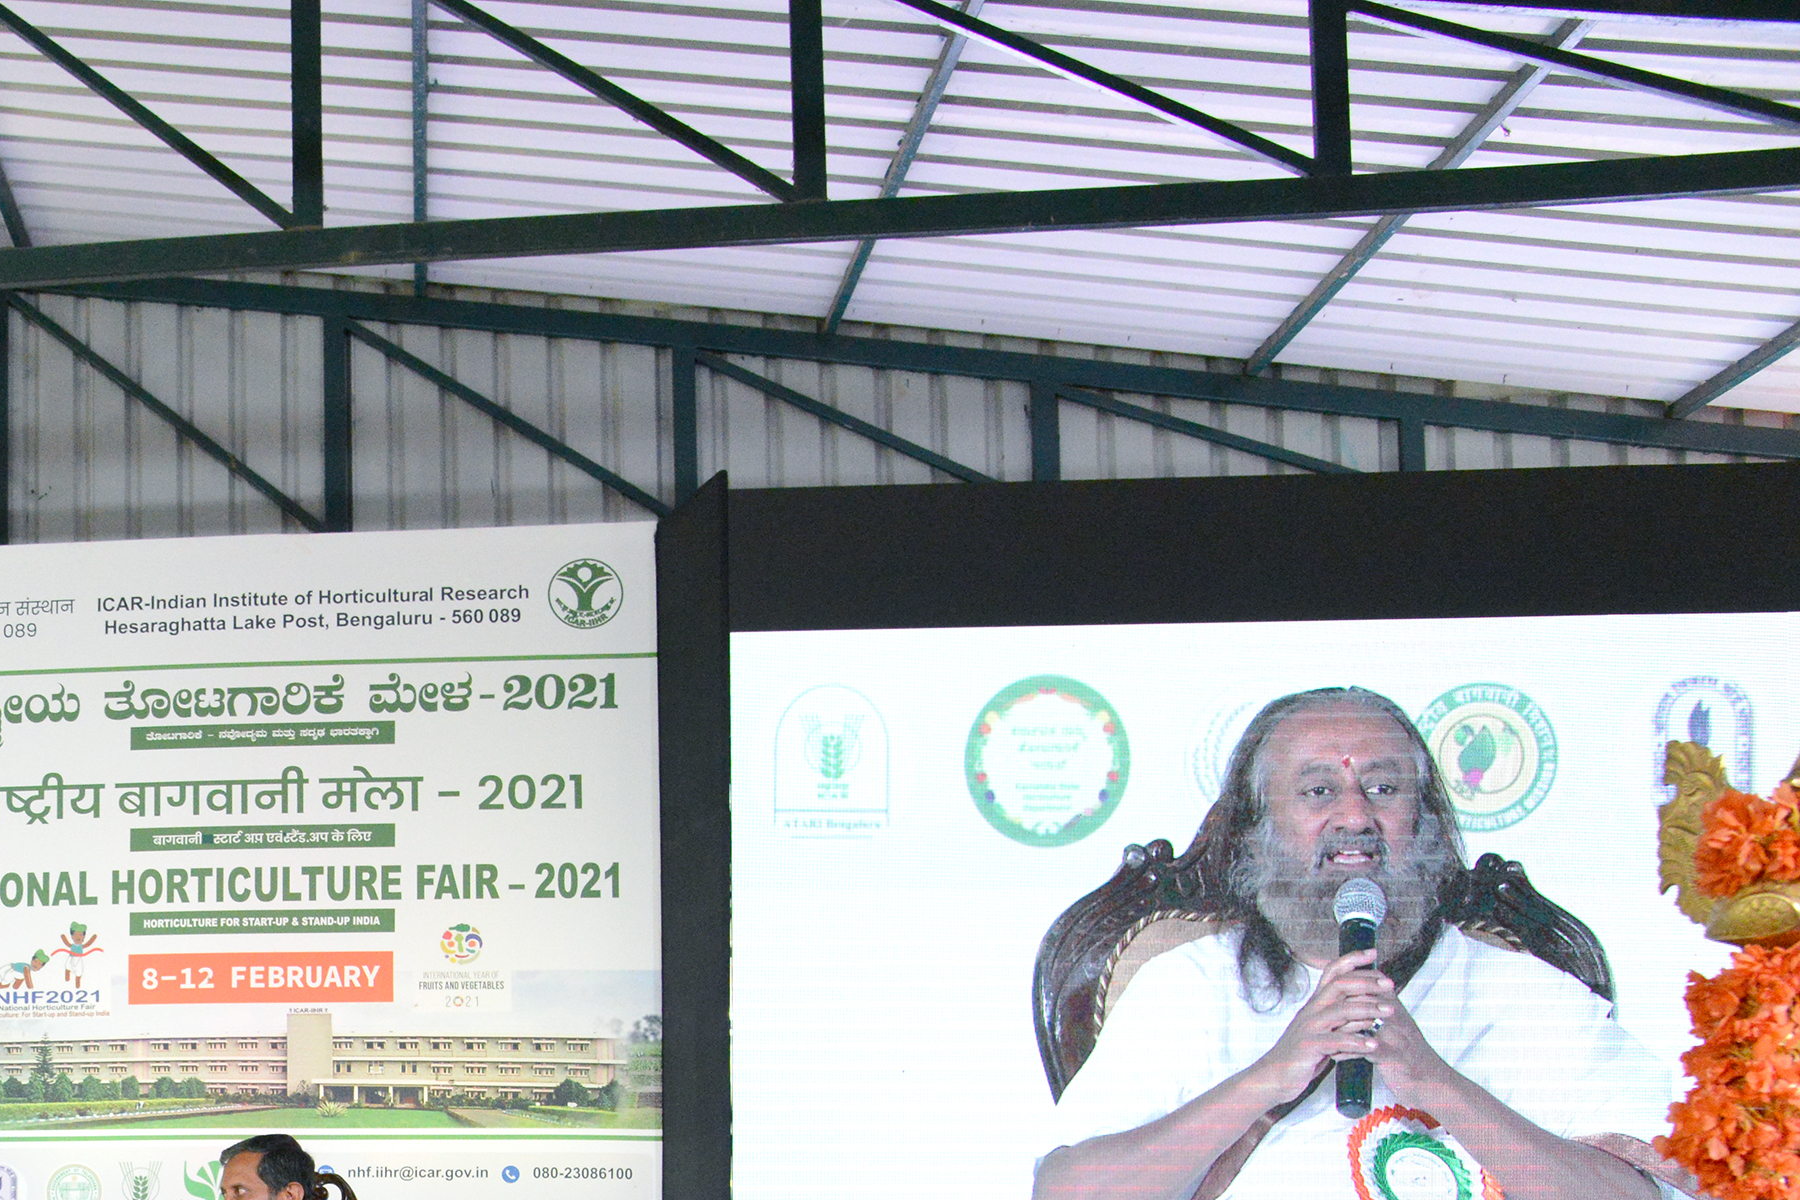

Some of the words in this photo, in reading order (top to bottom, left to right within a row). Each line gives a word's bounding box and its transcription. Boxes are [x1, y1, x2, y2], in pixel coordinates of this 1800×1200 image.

[15, 595, 75, 616] संस्थान
[97, 593, 208, 613] ICAR-Indian
[212, 590, 289, 609] Institute
[294, 589, 313, 606] of
[318, 586, 435, 605] Horticultural
[440, 584, 530, 602] Research
[3, 622, 38, 639] 089
[104, 615, 227, 638] Hesaraghatta
[232, 613, 277, 631] Lake
[283, 612, 330, 632] Post,
[336, 609, 433, 632] Bengaluru
[451, 608, 485, 626] 560
[488, 607, 522, 625] 089
[103, 673, 346, 722] ತೋಟಗಾರಿಕೆ
[115, 765, 309, 818] बागवानी
[477, 773, 585, 812] 2021
[153, 831, 203, 847] बागवानी
[213, 830, 243, 845] स्टार्ट
[331, 830, 345, 843] के
[347, 829, 372, 842] लिए
[111, 865, 402, 906] HORTICULTURE
[414, 862, 500, 902] FAIR
[535, 861, 622, 899] 2021
[143, 917, 218, 929] HORTICULTURE
[220, 917, 240, 927] FOR
[241, 916, 289, 928] START-UP
[291, 916, 299, 926] &
[301, 916, 350, 927] STAND-UP
[353, 915, 381, 926] INDIA
[231, 965, 381, 989] FEBRUARY
[422, 970, 471, 980] INTERNATIONAL
[473, 970, 491, 979] YEAR
[491, 970, 500, 979] OF
[418, 980, 444, 991] FRUITS
[445, 980, 460, 990] AND
[460, 980, 505, 990] VEGETABLES
[32, 1003, 78, 1011] Horticulture
[347, 1165, 490, 1182] nhf.iihr@icar.gov.in
[532, 1165, 634, 1181] 080-23086100
